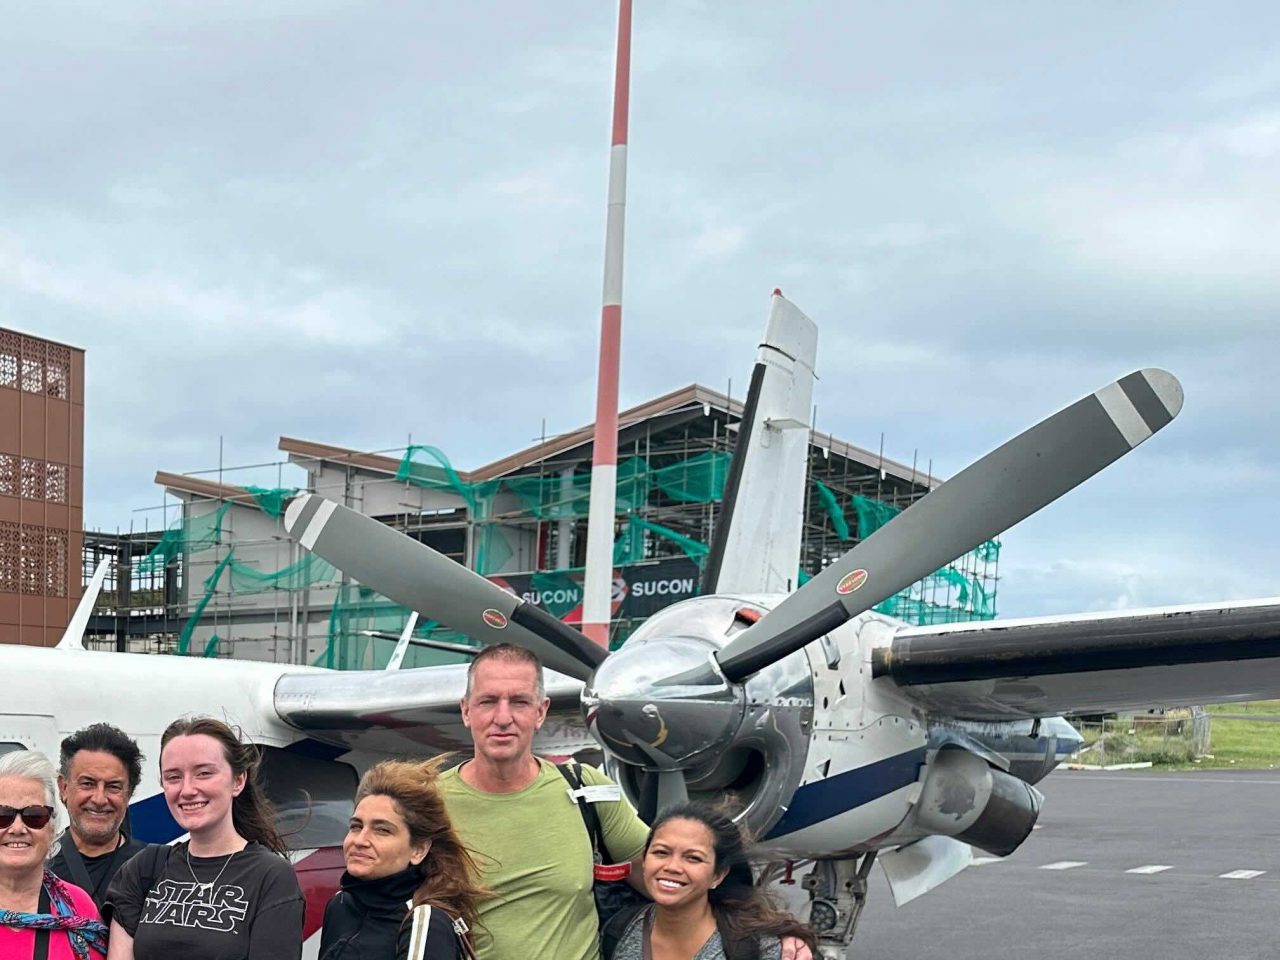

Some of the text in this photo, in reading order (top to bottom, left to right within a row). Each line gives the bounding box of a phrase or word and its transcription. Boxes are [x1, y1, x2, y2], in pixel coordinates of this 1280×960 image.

[522, 588, 578, 605] SUCON
[632, 578, 694, 597] SUCON
[145, 879, 249, 911] STAR
[140, 899, 247, 932] WARS
